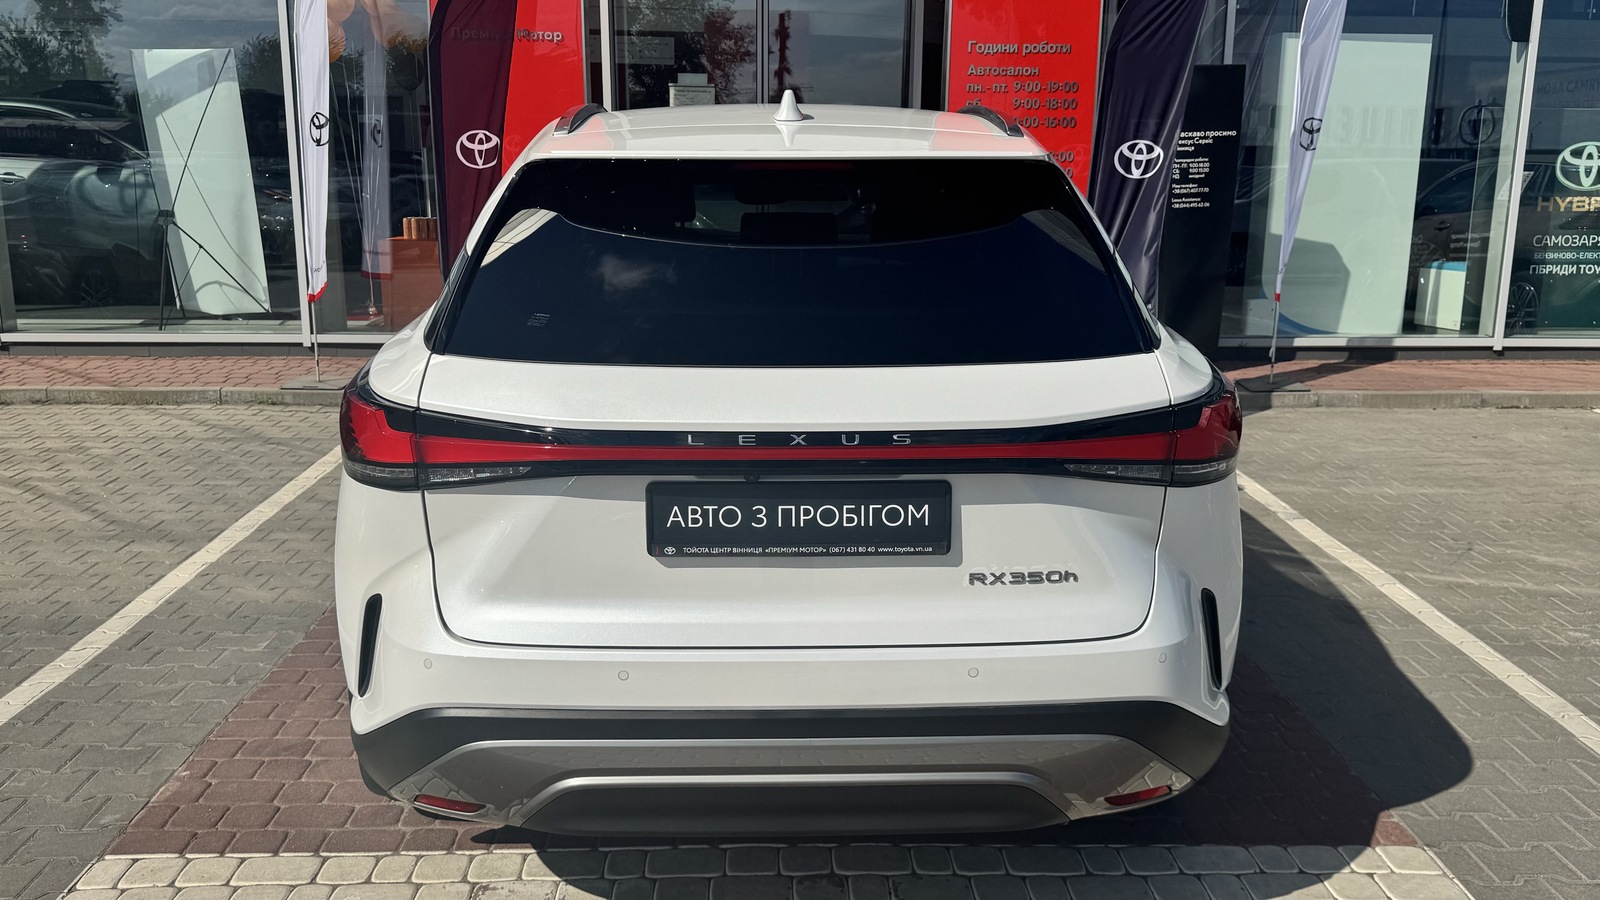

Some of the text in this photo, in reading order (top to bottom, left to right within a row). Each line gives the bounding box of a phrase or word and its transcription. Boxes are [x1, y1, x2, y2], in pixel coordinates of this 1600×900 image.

[517, 29, 563, 43] Мотор
[968, 41, 1071, 56] Години роботи
[967, 64, 1040, 76] Автосалон
[1013, 81, 1079, 93] 9:00-19:00
[1013, 98, 1078, 109] 9:00-18:00
[1206, 130, 1237, 138] просимо
[1533, 234, 1600, 247] САМОЗАР
[688, 433, 911, 446] LEXUS
[666, 505, 742, 528] АВТО
[777, 503, 930, 527] ПРОБІГОМ
[683, 545, 933, 555] ТОЙОТА ЦЕНТР ВІННИЦЯ «ПРЕМІУМ МОТОР» (067) 431 80 40 www.toyota.vn.ua
